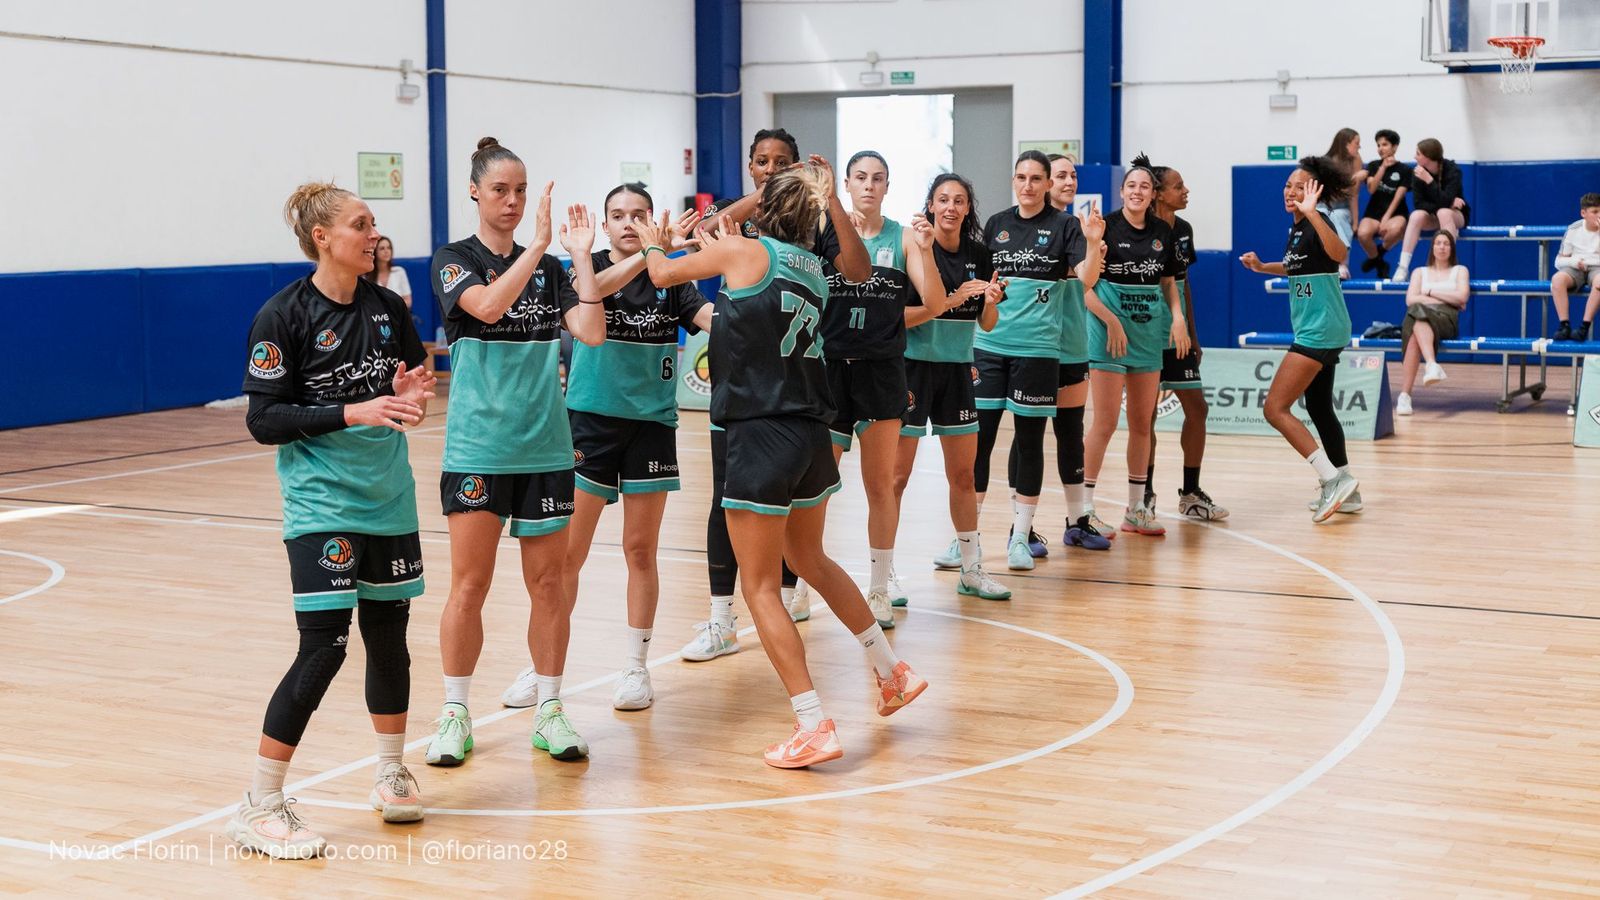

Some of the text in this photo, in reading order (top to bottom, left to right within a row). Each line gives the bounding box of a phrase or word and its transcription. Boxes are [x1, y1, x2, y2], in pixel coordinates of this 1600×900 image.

[1295, 281, 1313, 298] 24
[1120, 303, 1150, 312] MOTOR
[780, 290, 821, 359] 77
[849, 307, 866, 329] 11
[660, 356, 675, 381] 6
[331, 577, 351, 587] vive
